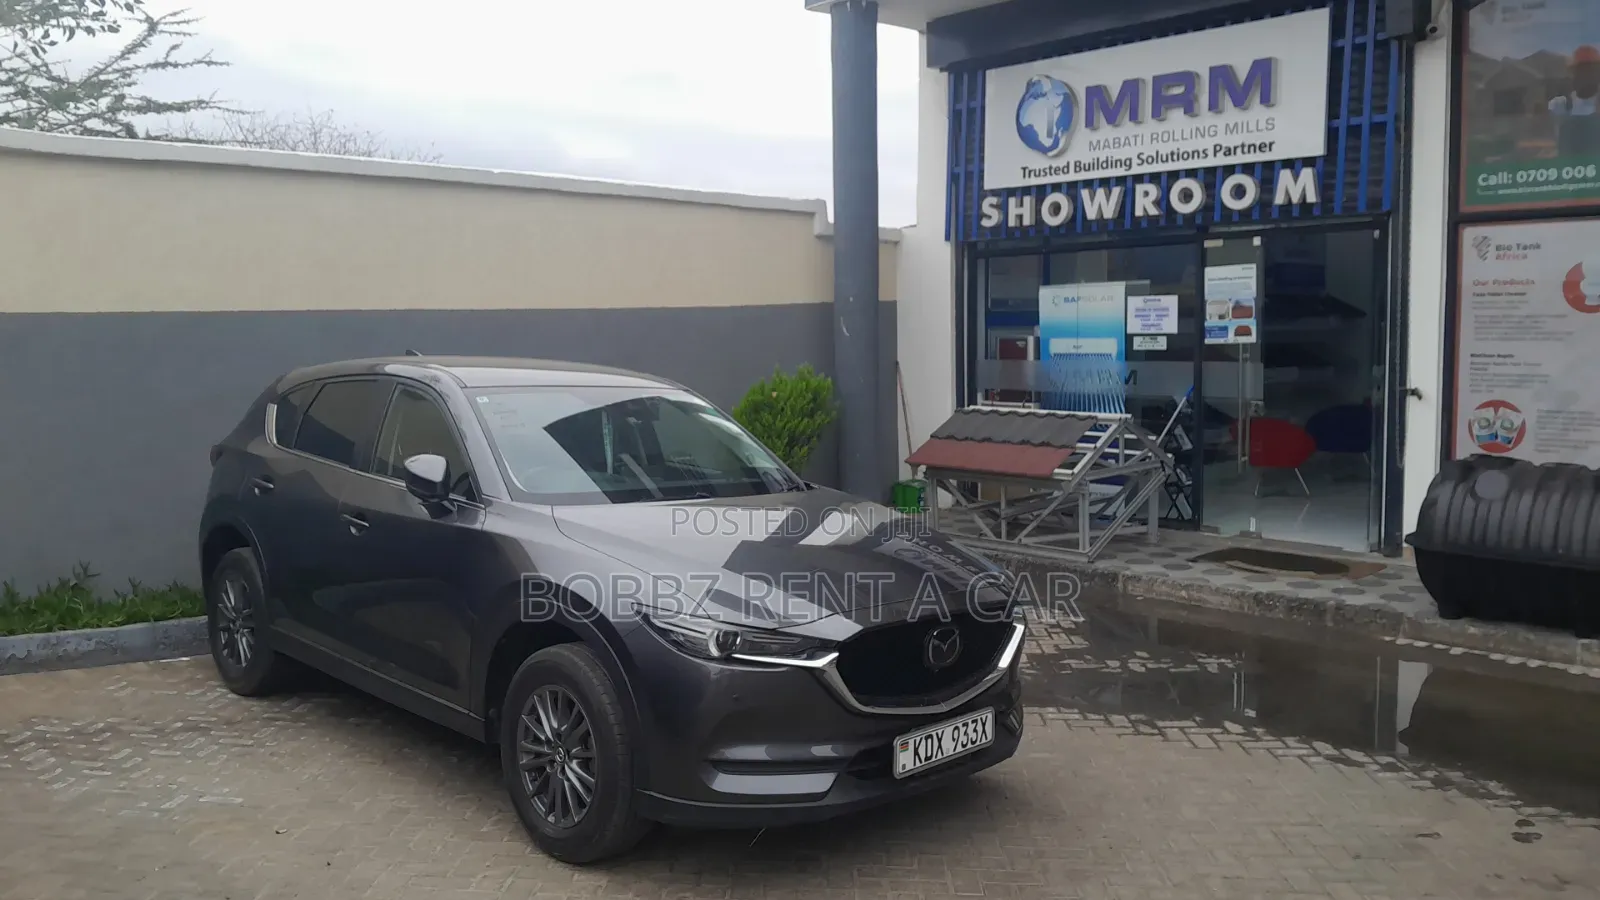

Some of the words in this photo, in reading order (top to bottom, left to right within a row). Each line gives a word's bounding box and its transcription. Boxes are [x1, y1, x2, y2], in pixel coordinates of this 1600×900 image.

[1085, 57, 1277, 131] MRM
[1088, 133, 1144, 152] MABATI
[1150, 124, 1218, 145] ROLLING
[1225, 117, 1276, 137] MILLS
[1021, 162, 1070, 180] Trusted
[1073, 155, 1133, 175] Building
[1136, 147, 1209, 168] Solutions
[1213, 140, 1276, 159] Partner
[1478, 171, 1513, 187] Call:
[1516, 168, 1558, 183] 0709
[1562, 164, 1597, 179] 006
[980, 166, 1321, 228] SHOWROOM
[1516, 242, 1542, 251] Tank
[912, 729, 945, 767] KDX
[951, 715, 989, 752] 933X
